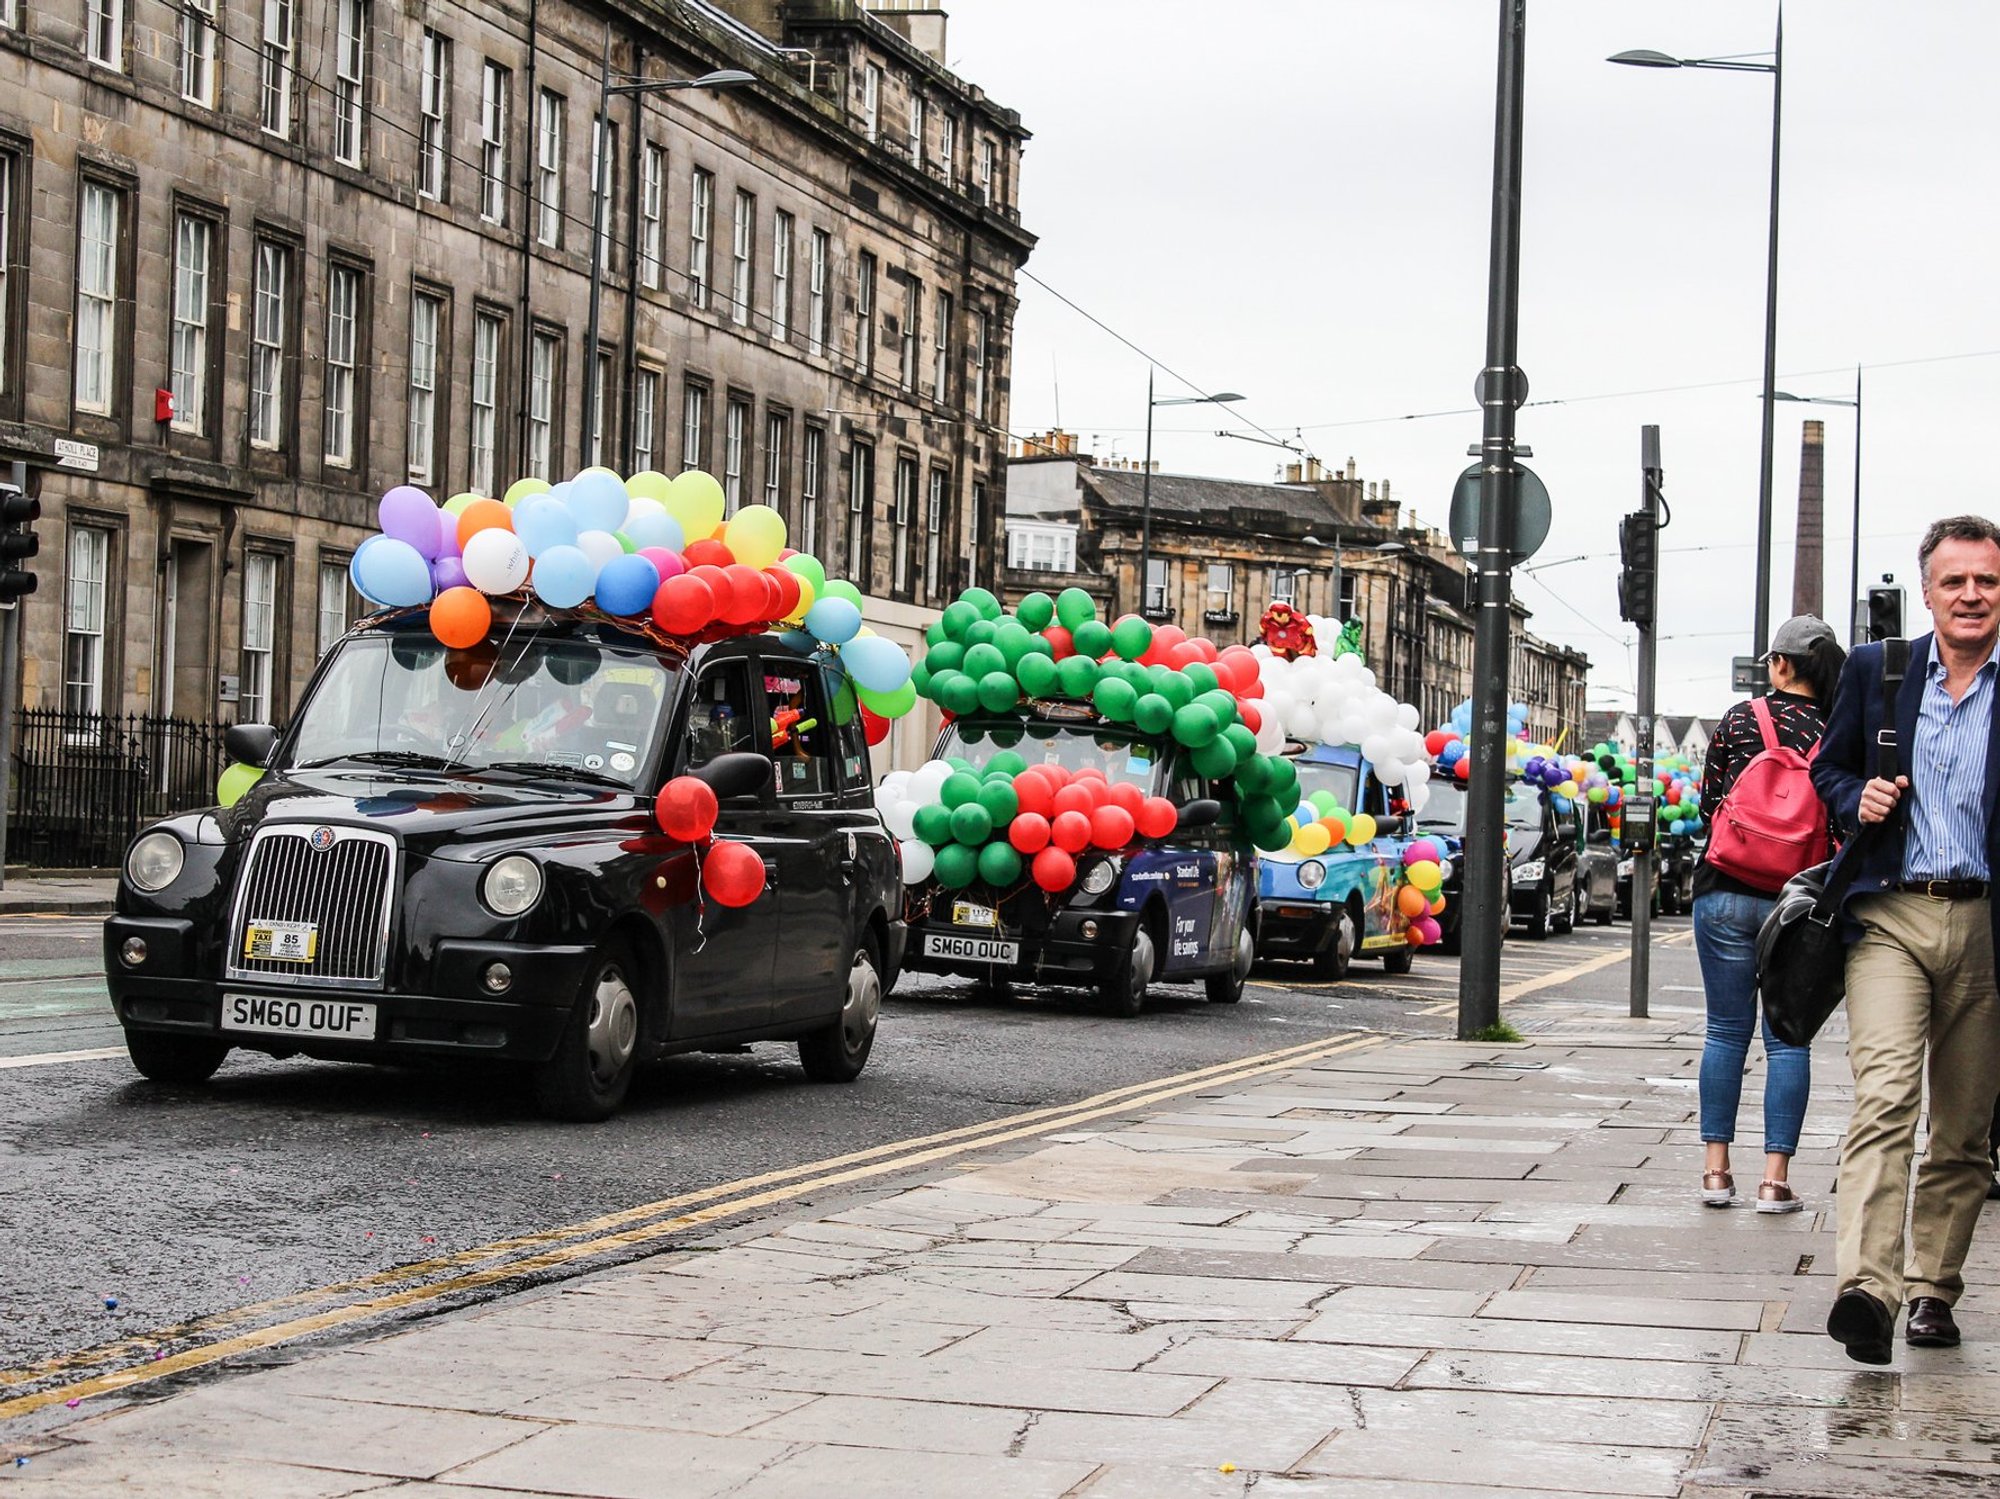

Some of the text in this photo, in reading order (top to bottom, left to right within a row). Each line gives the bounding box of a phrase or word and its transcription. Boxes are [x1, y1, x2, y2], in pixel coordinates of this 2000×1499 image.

[58, 442, 96, 458] ATHOLL PLACE
[1175, 916, 1195, 937] For your
[284, 933, 299, 944] 85
[932, 937, 1011, 959] SM60 OUC
[1174, 938, 1199, 959] life savings
[233, 998, 364, 1032] SM60 OUF
